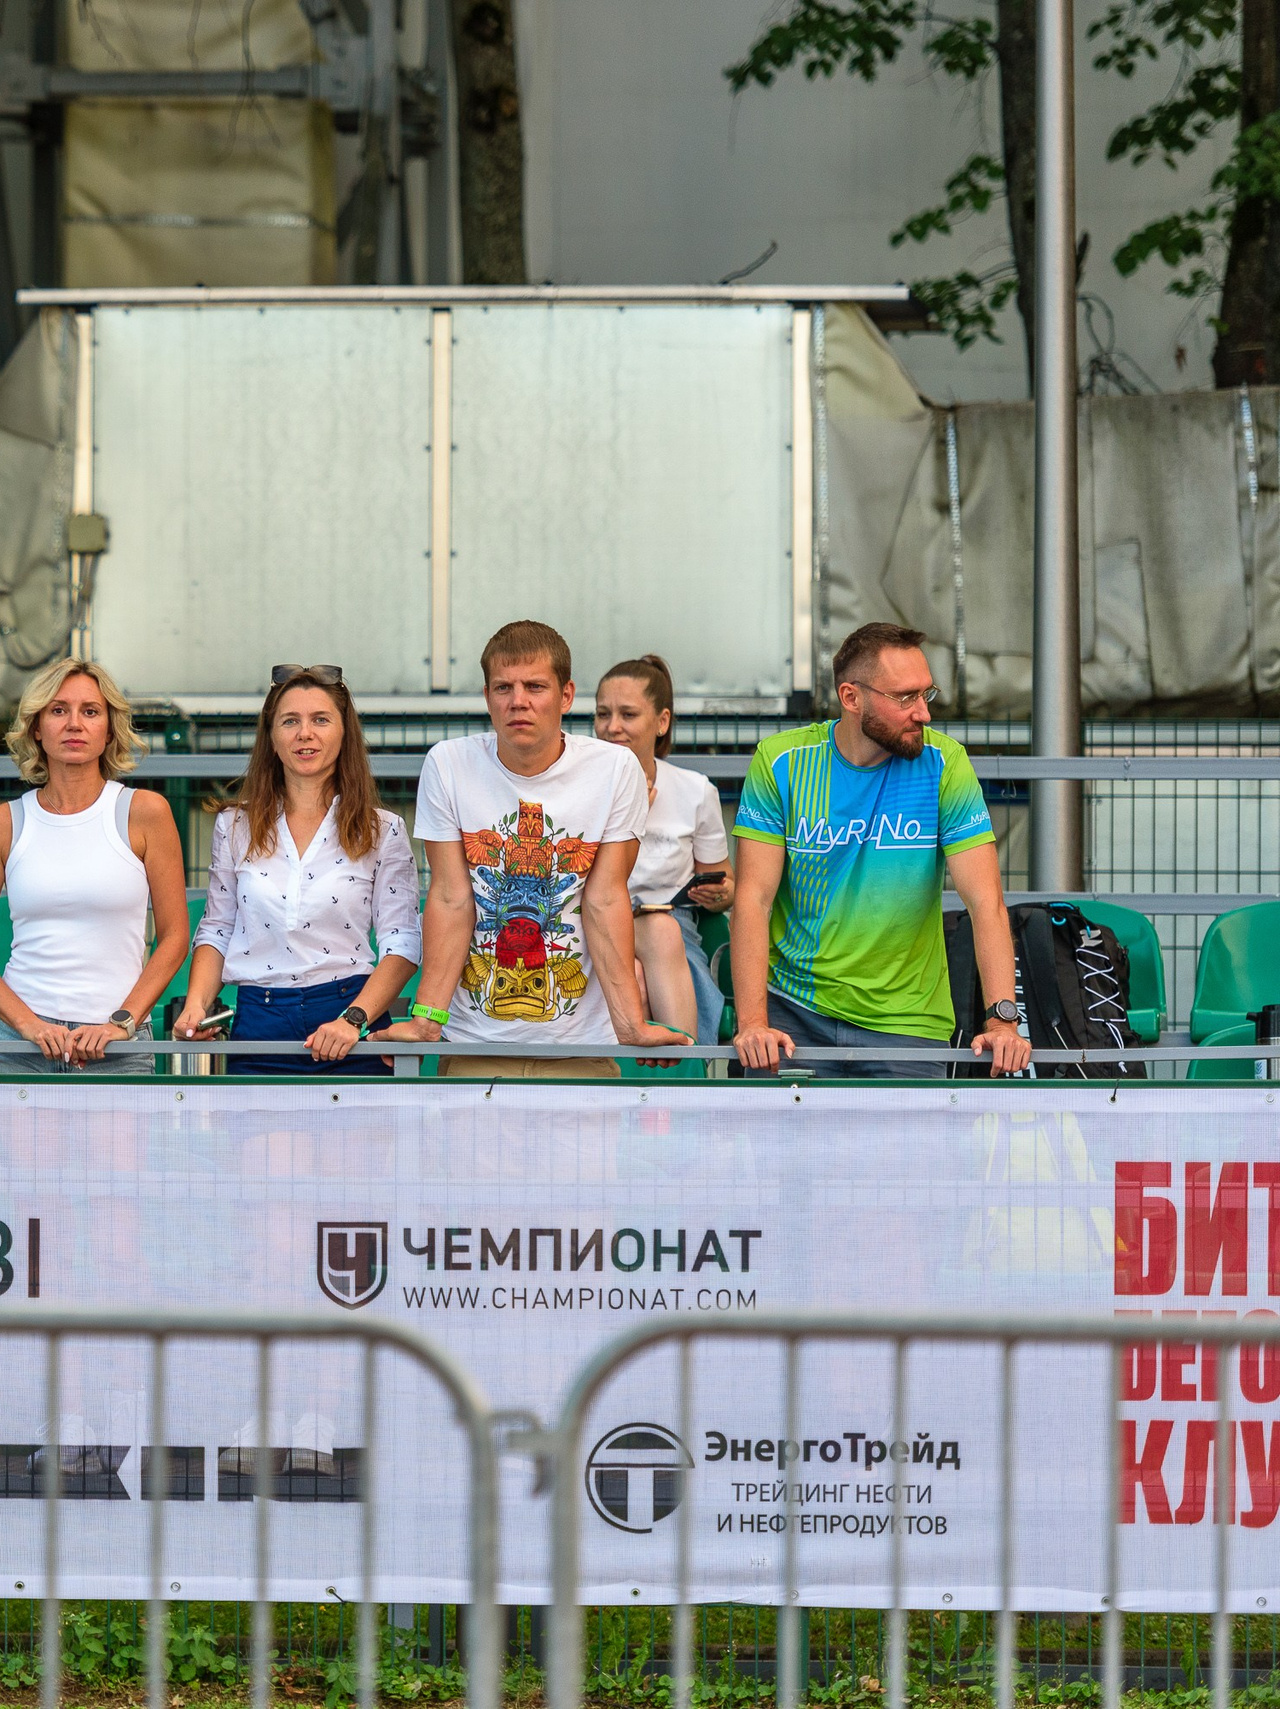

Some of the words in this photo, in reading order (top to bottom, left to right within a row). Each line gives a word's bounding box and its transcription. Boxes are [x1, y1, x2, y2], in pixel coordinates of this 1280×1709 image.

[403, 1227, 763, 1273] ЧЕМПИОНАТ
[402, 1286, 758, 1311] WWW.CHAMPIONAT.COM
[705, 1431, 961, 1471] ЭнергоТрейд
[731, 1480, 850, 1507] ТРЕЙДИНГ
[717, 1513, 732, 1533] И
